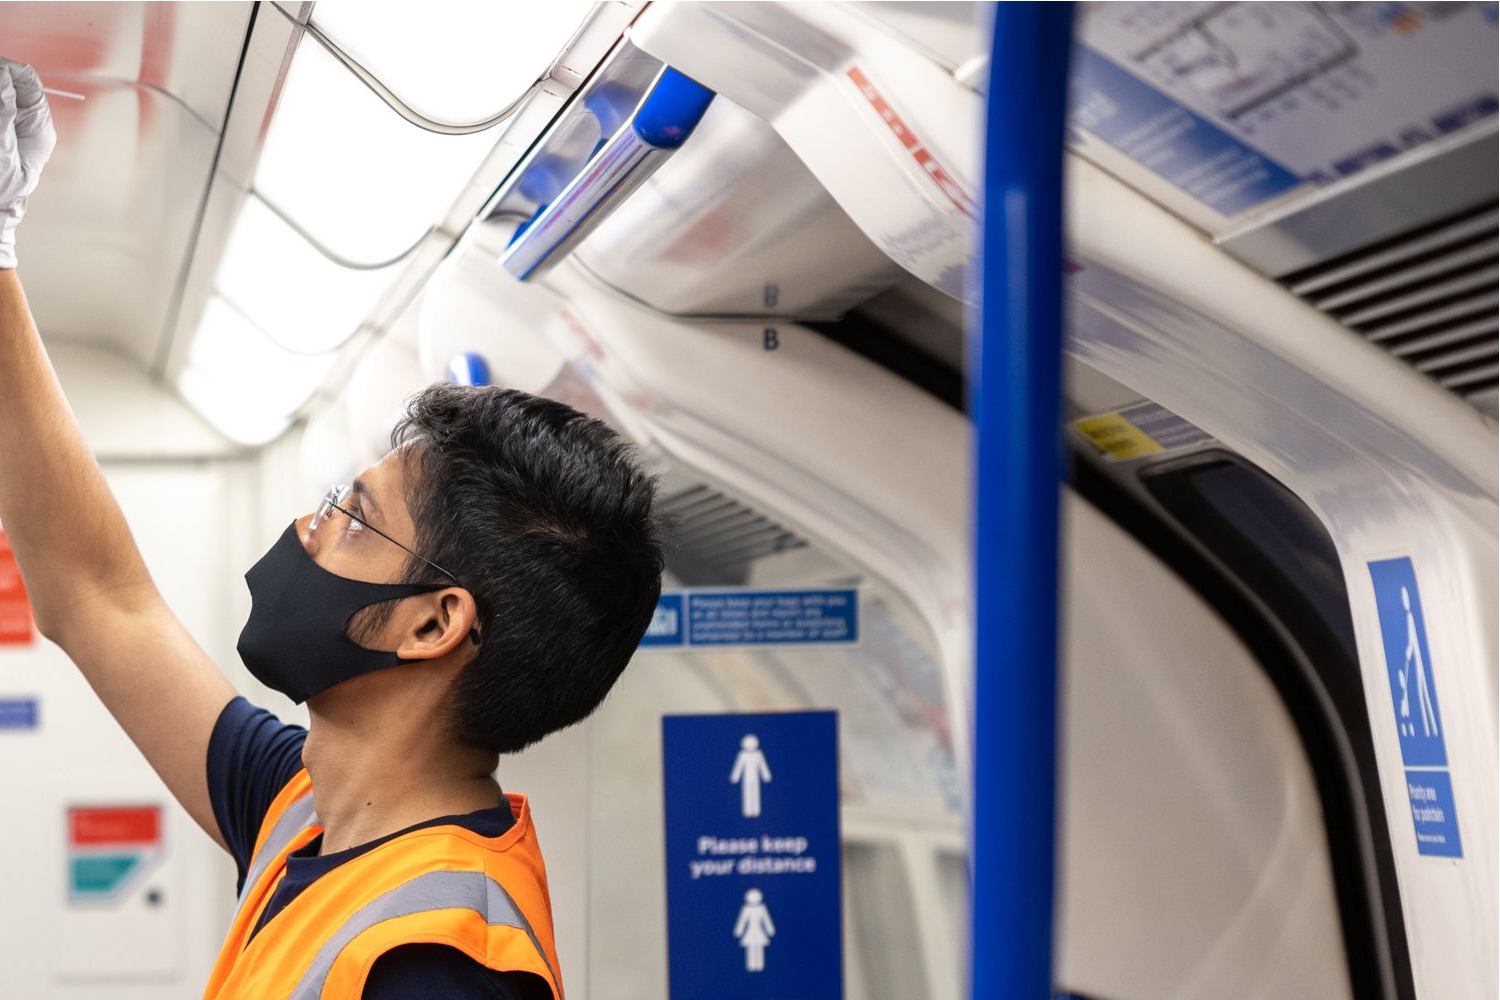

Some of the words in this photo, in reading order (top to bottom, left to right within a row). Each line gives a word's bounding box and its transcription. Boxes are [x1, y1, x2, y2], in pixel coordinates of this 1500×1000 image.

[763, 329, 779, 351] B
[698, 836, 758, 854] Please
[761, 835, 808, 854] keep
[690, 859, 734, 878] your
[737, 856, 816, 874] distance
